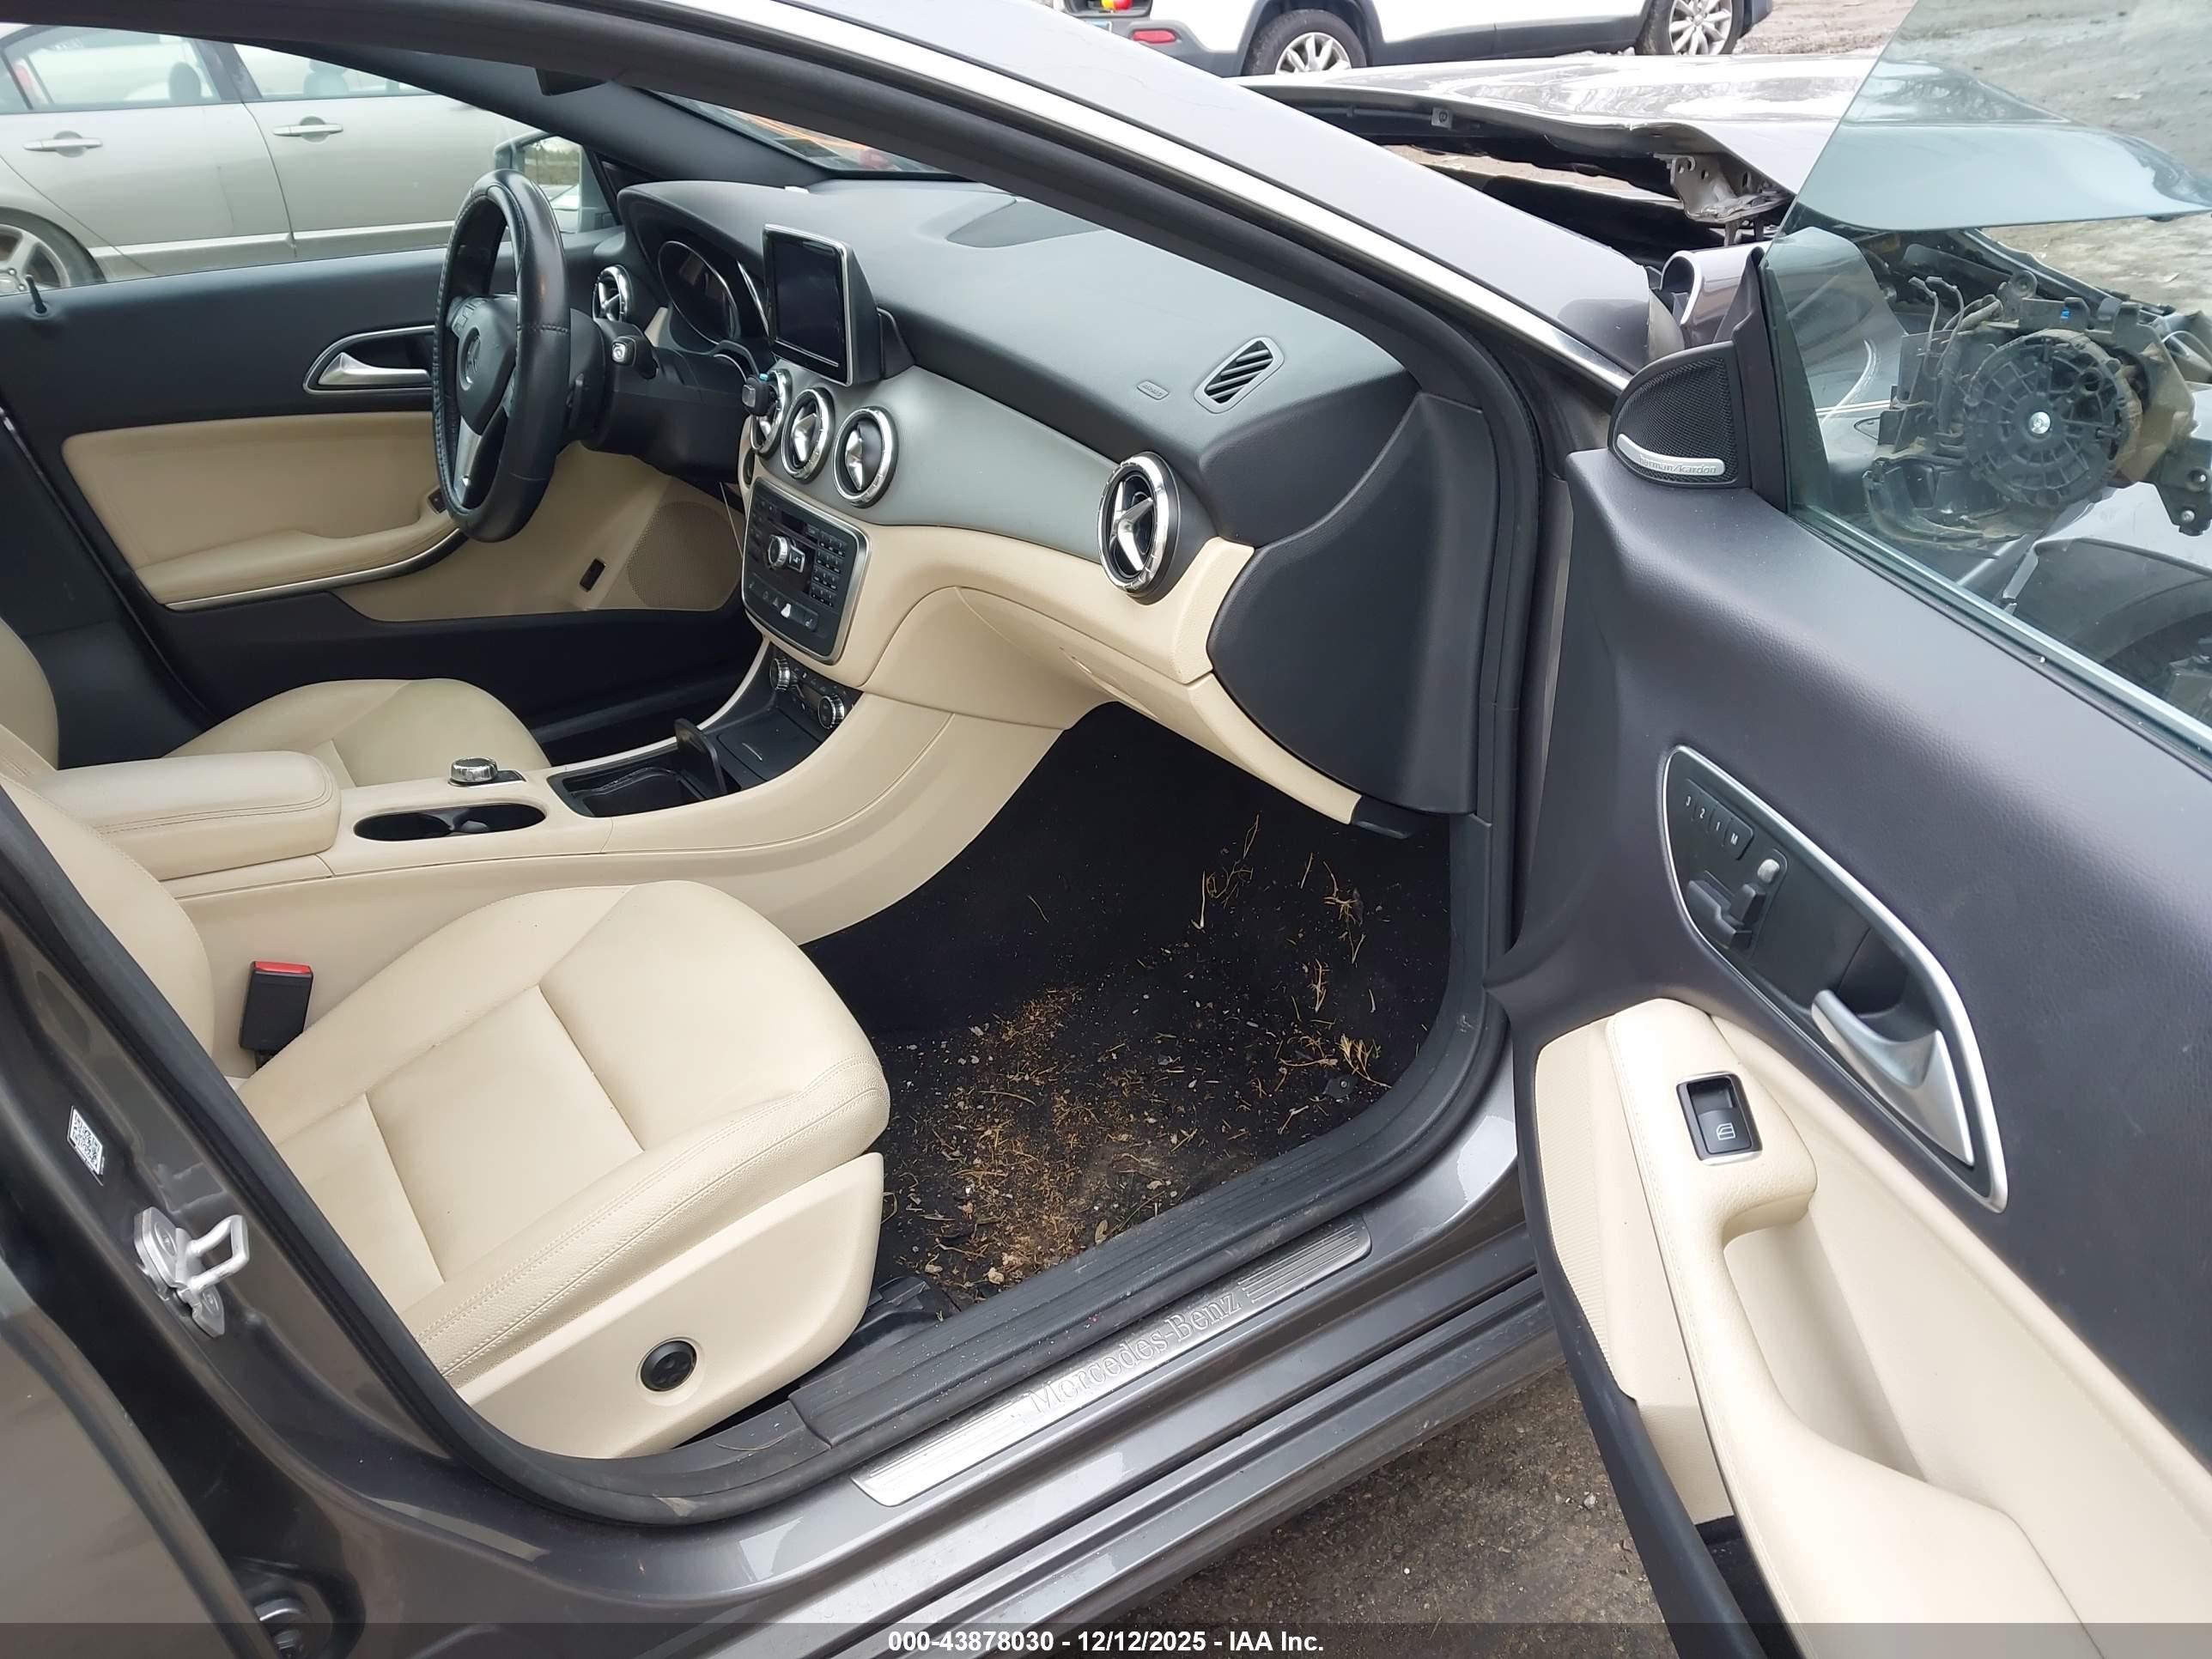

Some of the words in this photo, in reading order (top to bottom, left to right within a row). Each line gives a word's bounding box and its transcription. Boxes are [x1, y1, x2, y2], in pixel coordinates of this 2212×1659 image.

[1699, 807, 1705, 818] 2
[1730, 833, 1738, 845] M
[1030, 1292, 1242, 1414] Mercedes-Benz
